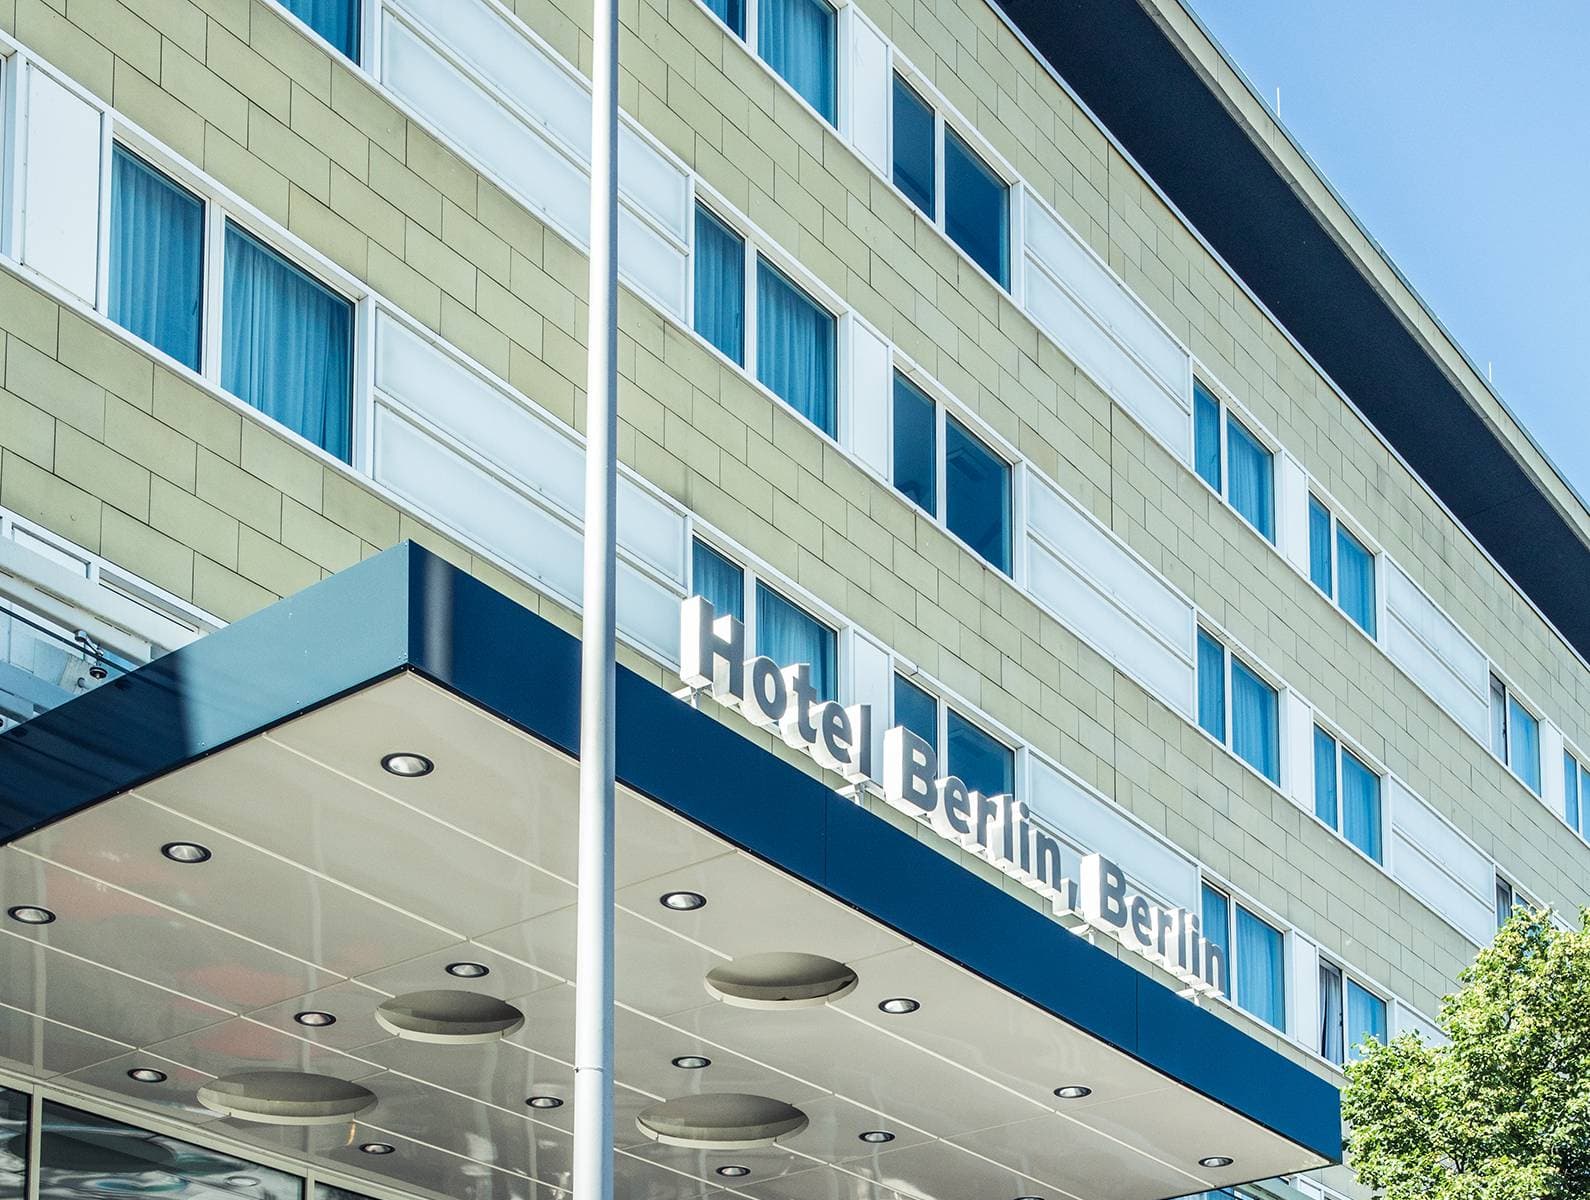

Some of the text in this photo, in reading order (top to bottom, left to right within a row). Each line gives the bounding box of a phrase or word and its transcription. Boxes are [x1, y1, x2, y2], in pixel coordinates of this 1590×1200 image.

[682, 595, 1225, 996] Hotel Berlin, Berlin
